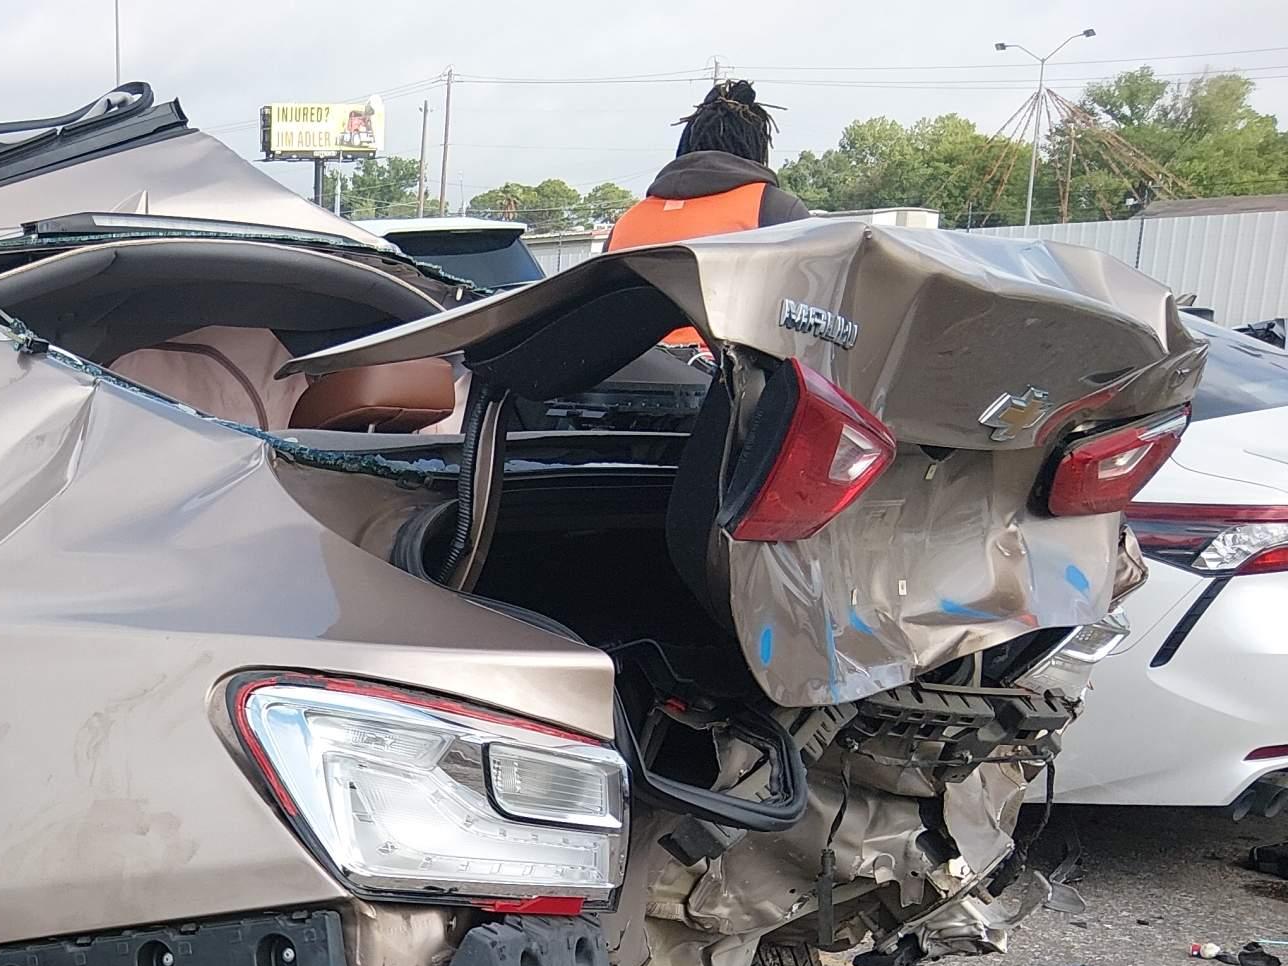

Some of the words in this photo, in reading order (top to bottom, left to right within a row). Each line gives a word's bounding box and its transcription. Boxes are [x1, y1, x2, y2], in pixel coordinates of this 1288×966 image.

[277, 106, 330, 123] INJURED?
[275, 131, 294, 148] JIM
[298, 131, 331, 148] ADLER
